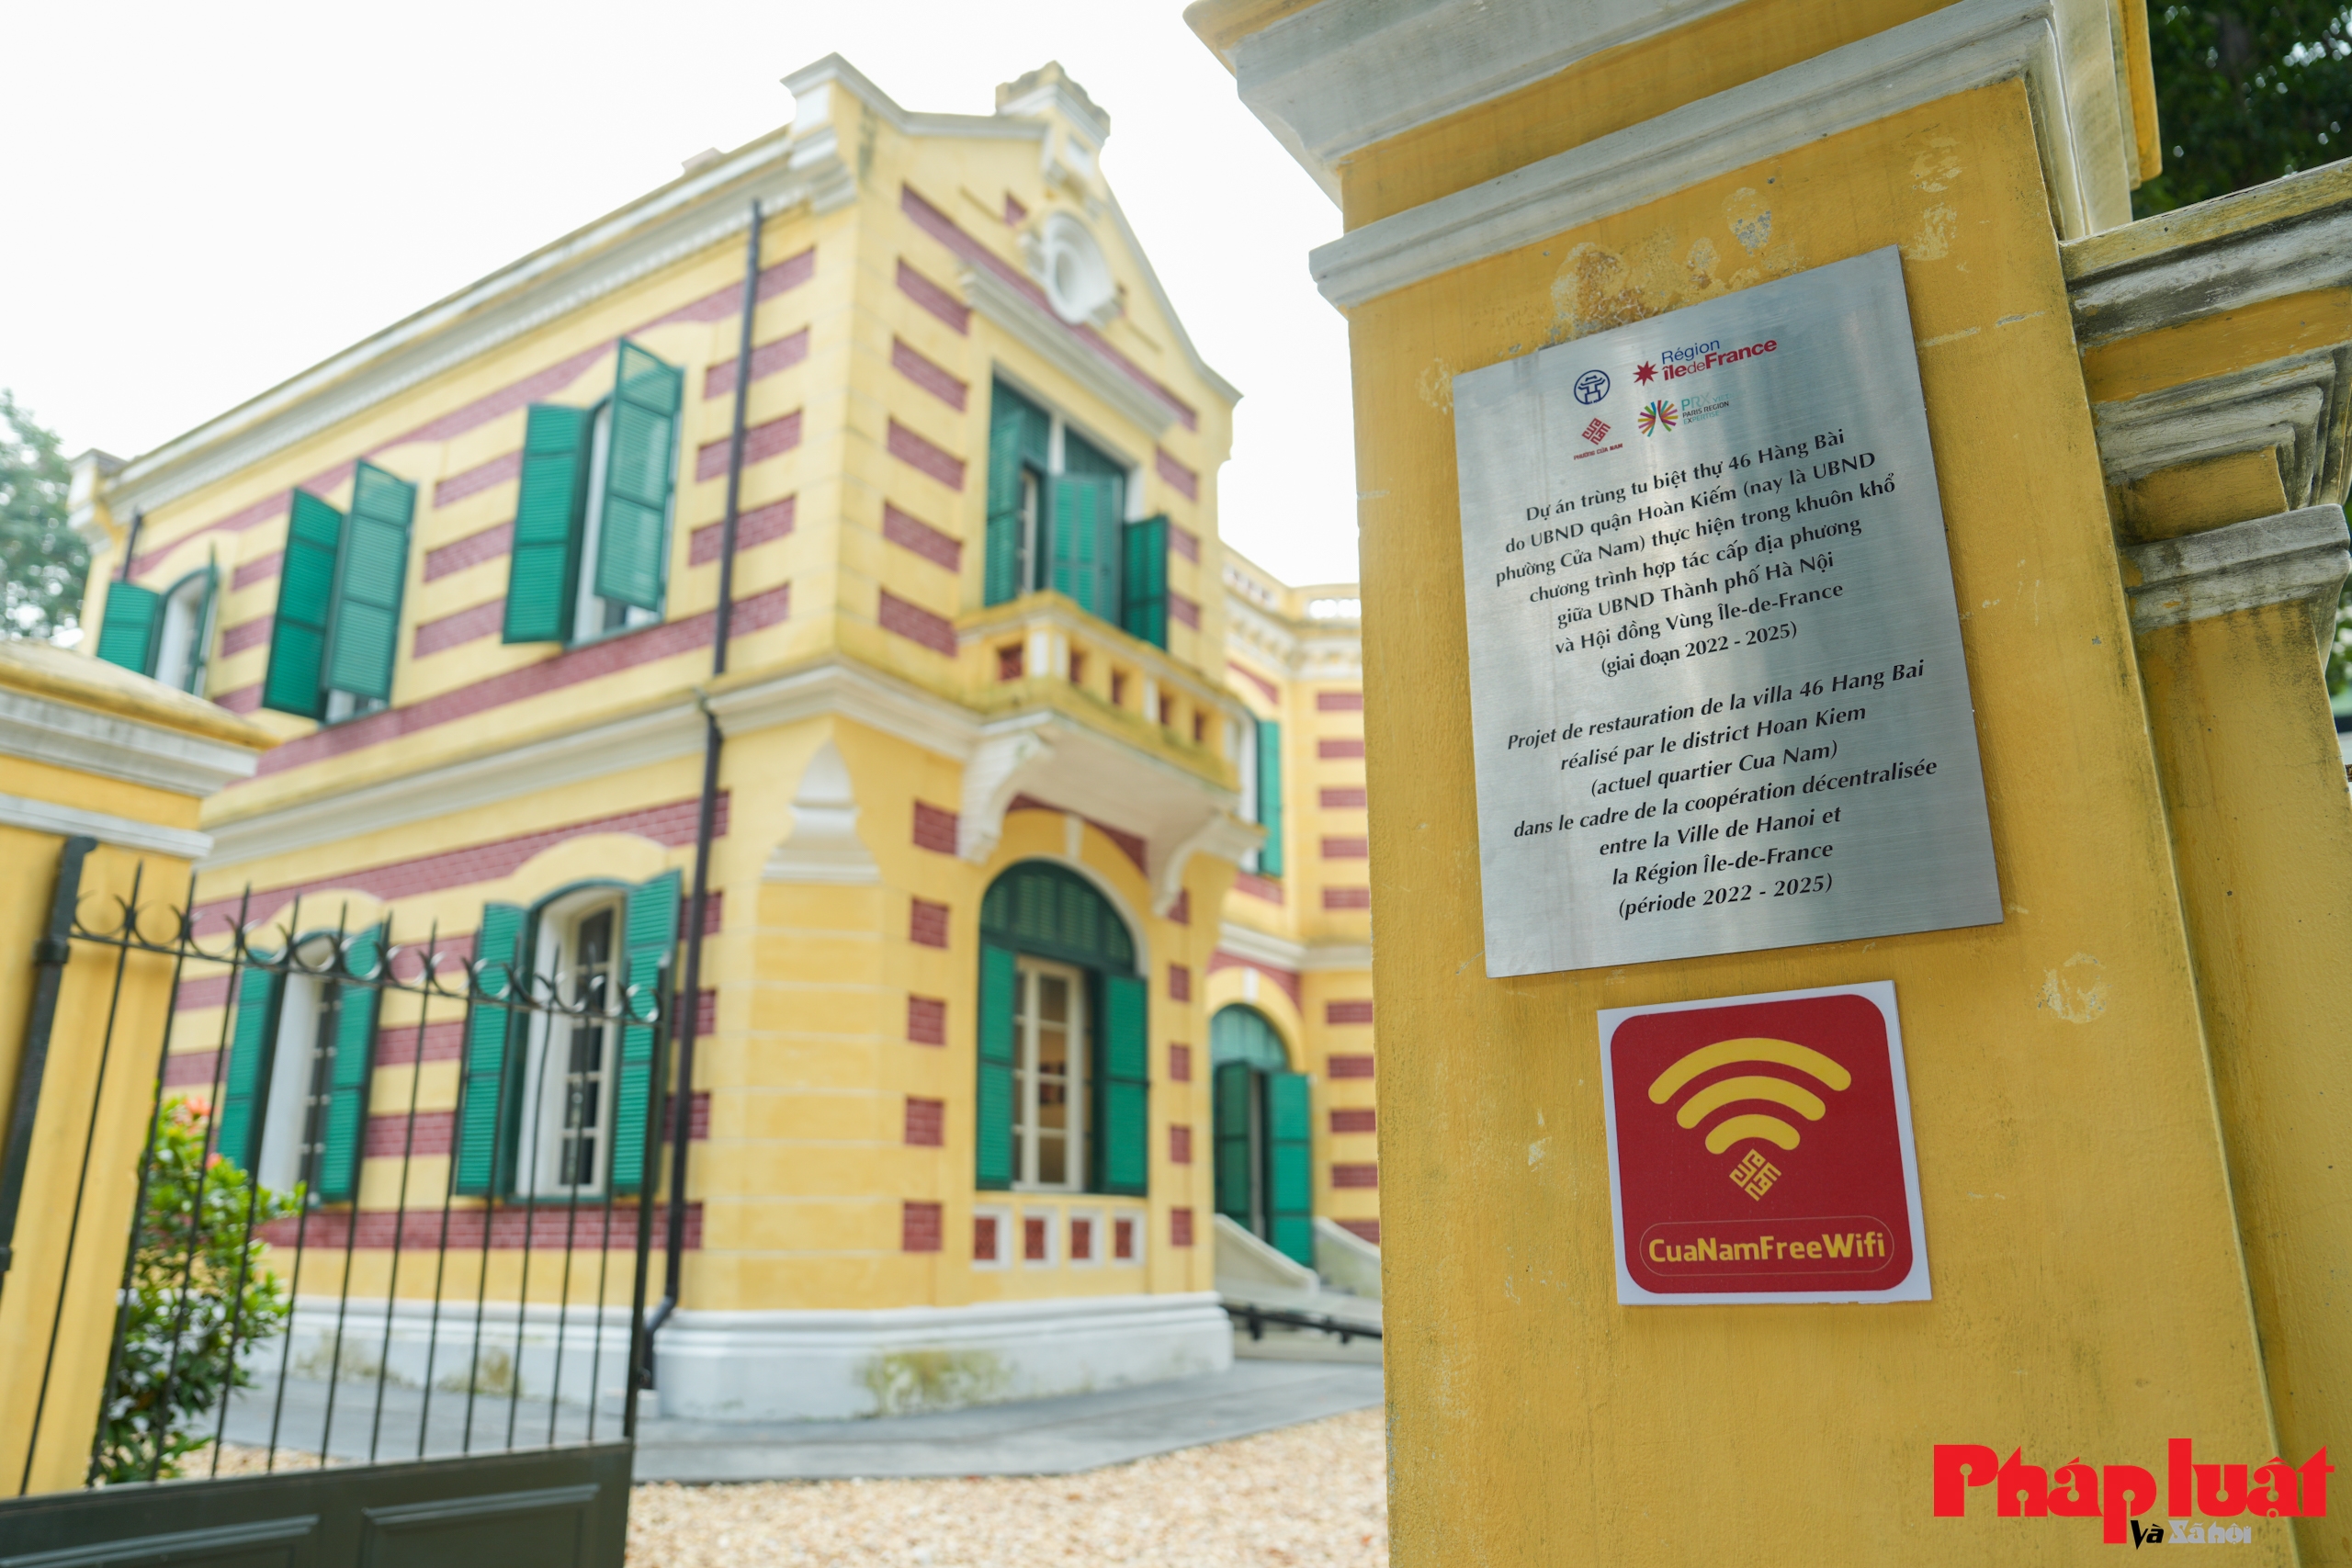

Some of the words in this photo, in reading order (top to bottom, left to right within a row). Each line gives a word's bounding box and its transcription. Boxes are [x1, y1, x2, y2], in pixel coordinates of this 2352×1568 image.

[1661, 340, 1720, 365] Région
[1681, 392, 1712, 412] PRX
[1682, 407, 1703, 419] PARIS
[1703, 400, 1730, 412] REGION
[1683, 410, 1721, 425] EXPERTISE
[1526, 503, 1552, 522] Dự
[1555, 499, 1576, 514] án
[1580, 487, 1627, 508] trùng
[1631, 481, 1648, 495] tu
[1653, 469, 1687, 490] biệt
[1692, 460, 1724, 480] thự
[1728, 453, 1751, 470] 46
[1758, 442, 1809, 464] Hàng
[1814, 428, 1845, 450] Bài
[1610, 443, 1623, 451] NAM
[1496, 559, 1556, 588] phường
[1560, 548, 1593, 568] Cửa
[1598, 535, 1645, 559] Nam)
[1651, 528, 1690, 547] thực
[1695, 517, 1736, 537] hiện
[1740, 505, 1792, 526] trong
[1795, 490, 1854, 514] khuôn
[1859, 472, 1895, 499] khổ
[1505, 537, 1526, 553] do
[1531, 523, 1584, 547] UBND
[1589, 513, 1632, 536] quận
[1637, 501, 1685, 522] Hoàn
[1690, 485, 1736, 510] Kiếm
[1743, 478, 1782, 498] (nay
[1789, 468, 1807, 486] là
[1813, 452, 1876, 479] UBND
[1529, 580, 1590, 603] chương
[1594, 566, 1637, 589] trình
[1643, 561, 1676, 579] hợp
[1681, 551, 1710, 570] tác
[1715, 539, 1748, 562] cấp
[1754, 534, 1784, 555] địa
[1790, 519, 1862, 550] phương
[1555, 637, 1575, 654] và
[1580, 628, 1611, 649] Hội
[1617, 619, 1661, 642] đồng
[1665, 612, 1713, 631] Vùng
[1717, 585, 1843, 621] Île-de-France
[1557, 606, 1593, 630] giữa
[1598, 592, 1655, 616] UBND
[1659, 577, 1718, 603] Thành
[1724, 564, 1760, 595] phố
[1765, 561, 1793, 581] Hà
[1799, 551, 1834, 573] Nội
[1600, 652, 1635, 678] (giai
[1639, 649, 1680, 667] đoạn
[1684, 636, 1729, 658] 2022
[1745, 620, 1797, 646] 2025)
[1507, 728, 1557, 750] Projet
[1562, 722, 1583, 740] de
[1589, 705, 1695, 736] restauration
[1701, 697, 1724, 716] de
[1729, 693, 1746, 711] la
[1752, 684, 1792, 706] villa
[1799, 679, 1824, 697] 46
[1831, 671, 1885, 693] Hang
[1892, 659, 1925, 682] Bai
[1560, 745, 1619, 771] réalisé
[1623, 743, 1655, 765] par
[1660, 736, 1677, 754] le
[1682, 724, 1750, 750] district
[1757, 717, 1808, 738] Hoan
[1815, 707, 1866, 728] Kiem
[1590, 769, 1652, 798] (actuel
[1657, 760, 1733, 790] quartier
[1738, 754, 1775, 772] Cua
[1782, 739, 1838, 765] Nam)
[1513, 819, 1554, 838] dans
[1558, 814, 1575, 831] le
[1579, 807, 1629, 828] cadre
[1634, 801, 1657, 820] de
[1662, 797, 1679, 816] la
[1684, 782, 1795, 813] coopération
[1802, 758, 1938, 795] décentralisée
[1599, 837, 1647, 856] entre
[1653, 830, 1669, 849] la
[1677, 823, 1720, 845] Ville
[1724, 818, 1749, 839] de
[1756, 807, 1815, 834] Hanoi
[1822, 807, 1841, 824] et
[1612, 867, 1629, 886] la
[1634, 860, 1698, 886] Région
[1703, 844, 1834, 874] Île-de-France
[1618, 890, 1696, 921] (période
[1702, 884, 1752, 907] 2022
[1772, 872, 1833, 897] 2025)
[1648, 1231, 1886, 1263] CuaNamFreeWifi
